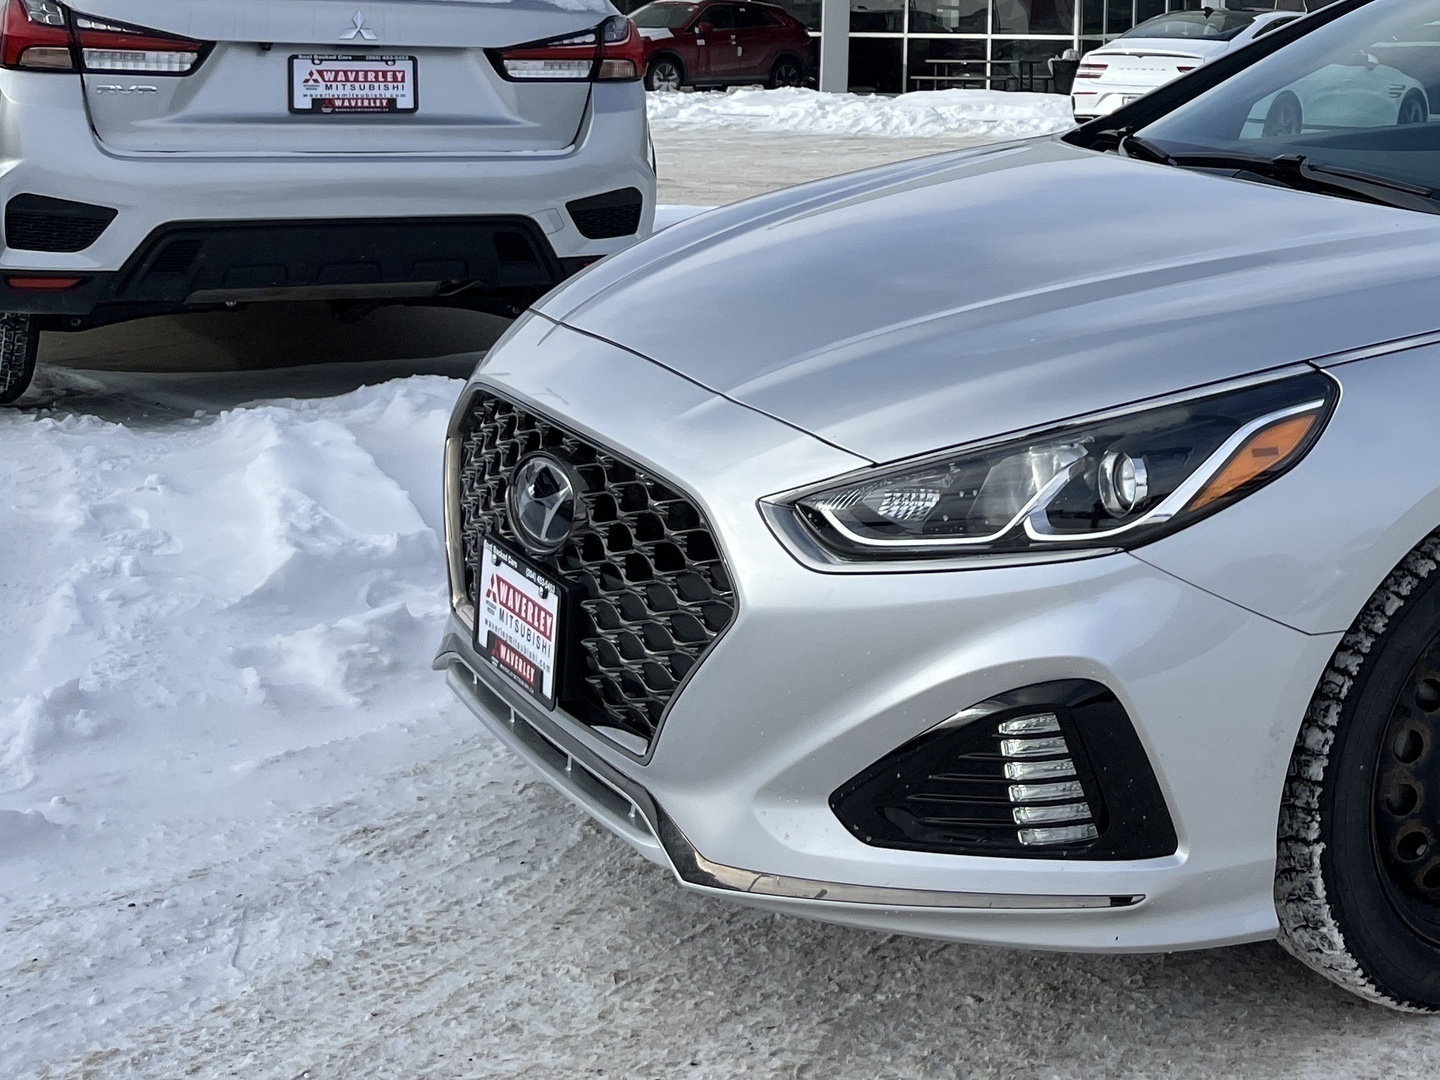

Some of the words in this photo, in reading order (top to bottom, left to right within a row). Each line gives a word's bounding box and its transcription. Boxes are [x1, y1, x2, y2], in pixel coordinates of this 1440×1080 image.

[323, 71, 405, 81] WAVERLEY
[96, 84, 157, 94] RVR
[334, 99, 389, 107] WAVERLEY
[500, 580, 553, 637] WAVERLEY
[499, 607, 551, 658] MITSUBISHI
[500, 643, 535, 682] WAVERLEY
